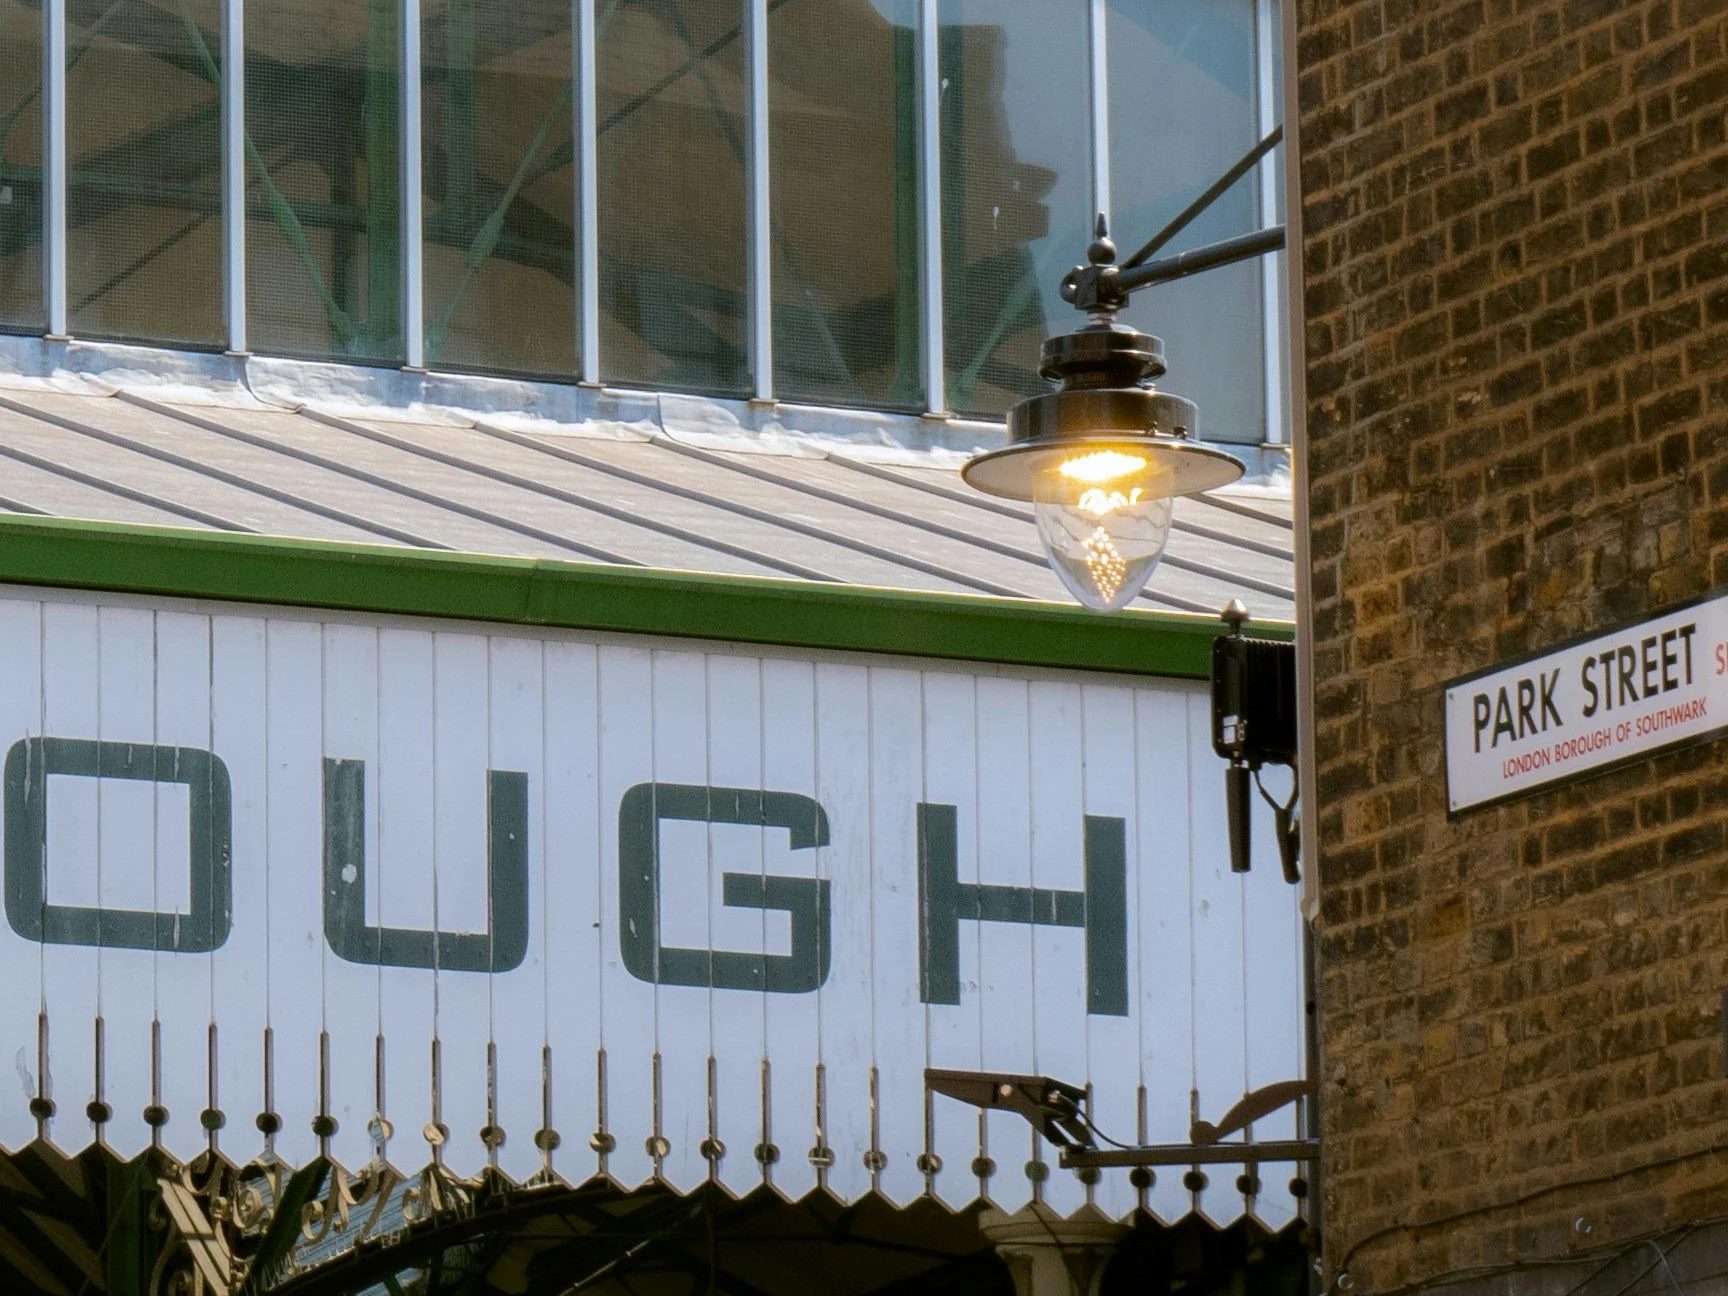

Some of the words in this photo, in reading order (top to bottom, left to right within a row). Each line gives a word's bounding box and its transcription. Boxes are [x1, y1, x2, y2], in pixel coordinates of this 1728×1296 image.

[1473, 667, 1564, 754] PARK
[1581, 622, 1697, 718] STREET
[1714, 640, 1728, 675] S
[1502, 748, 1551, 780] LONDON
[1554, 727, 1612, 764] BOROUGH
[1615, 721, 1632, 742] OF
[1635, 696, 1708, 737] SOUTHWARK
